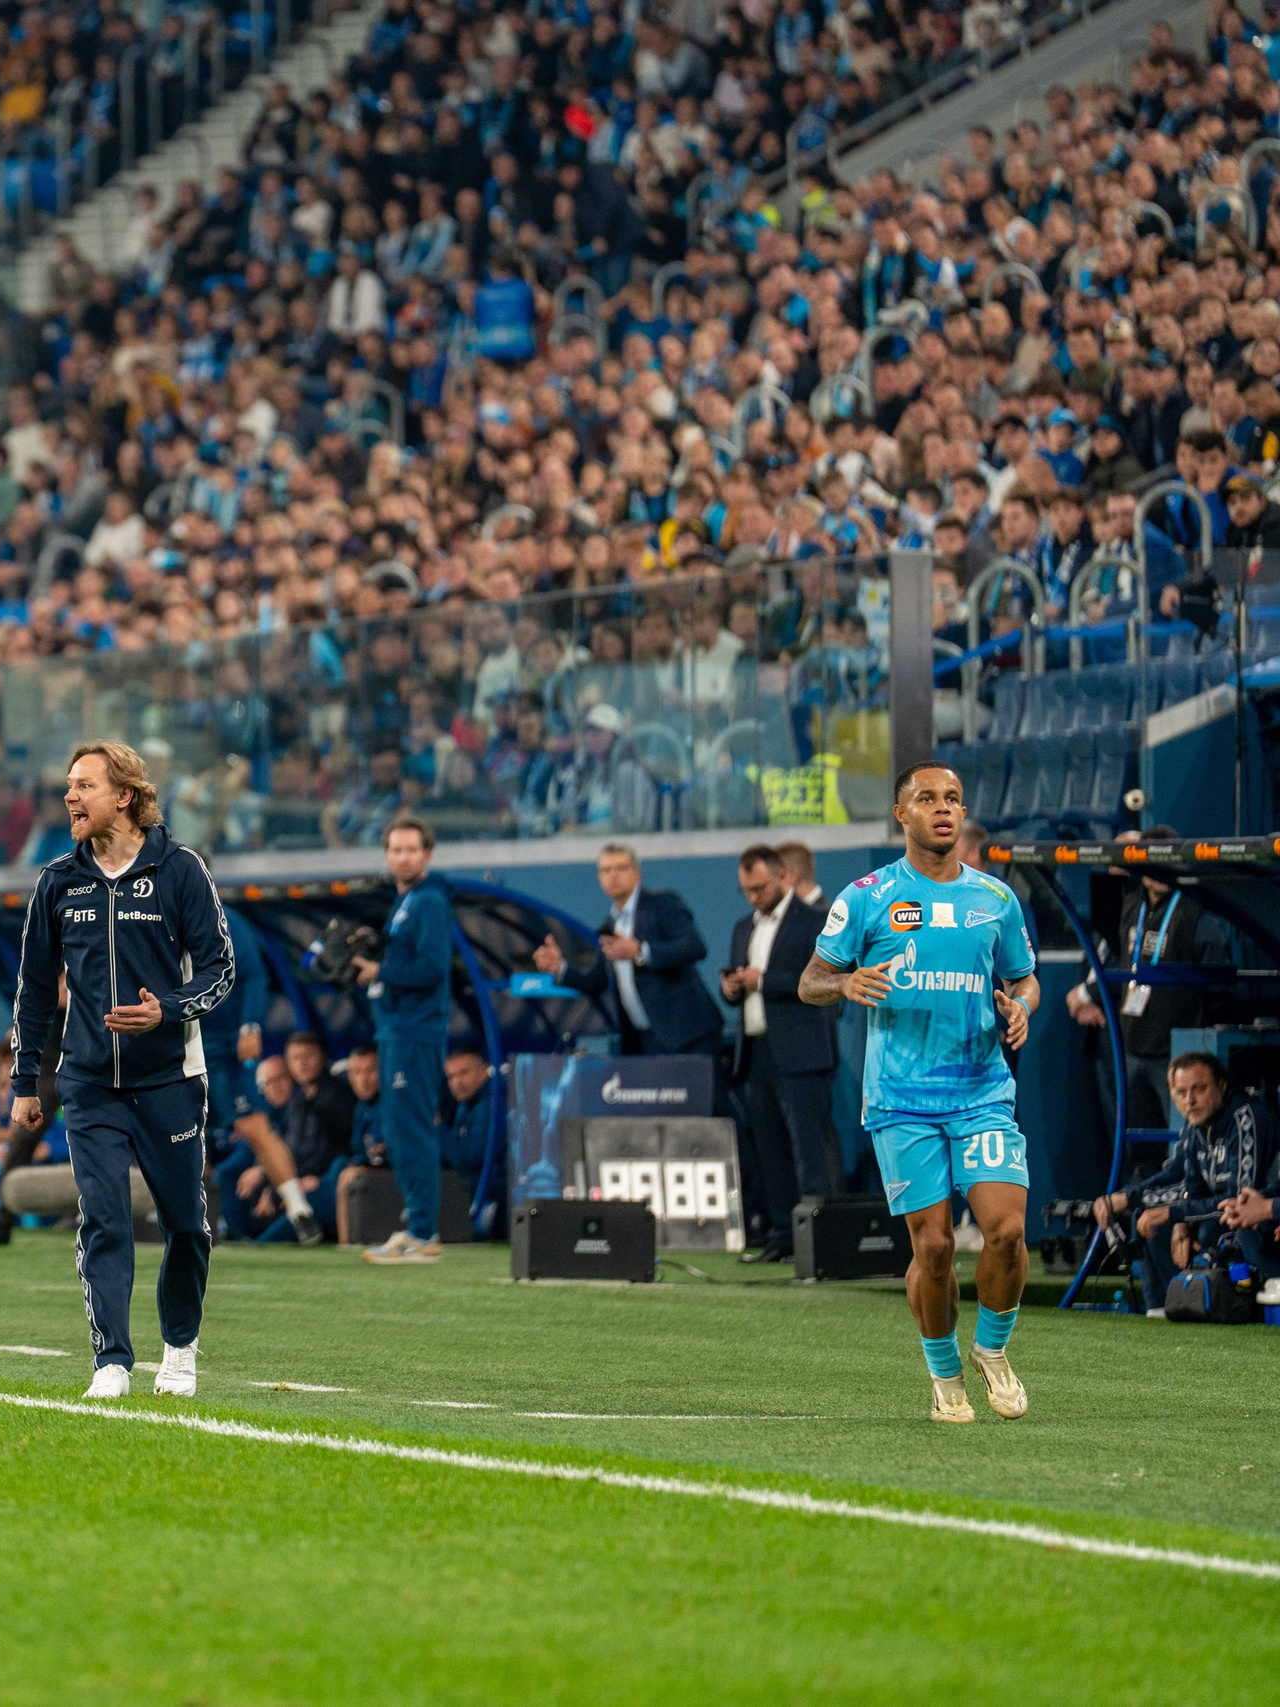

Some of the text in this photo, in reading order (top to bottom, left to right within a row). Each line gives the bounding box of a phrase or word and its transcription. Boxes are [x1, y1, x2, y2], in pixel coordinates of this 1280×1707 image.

[68, 885, 93, 896] BOSCO
[73, 909, 96, 922] ВТБ
[117, 911, 162, 921] BetBoom
[897, 911, 920, 922] WIN
[919, 970, 984, 994] ГАЗПРОМ
[171, 1129, 197, 1143] BOSCO
[963, 1130, 1005, 1169] 20
